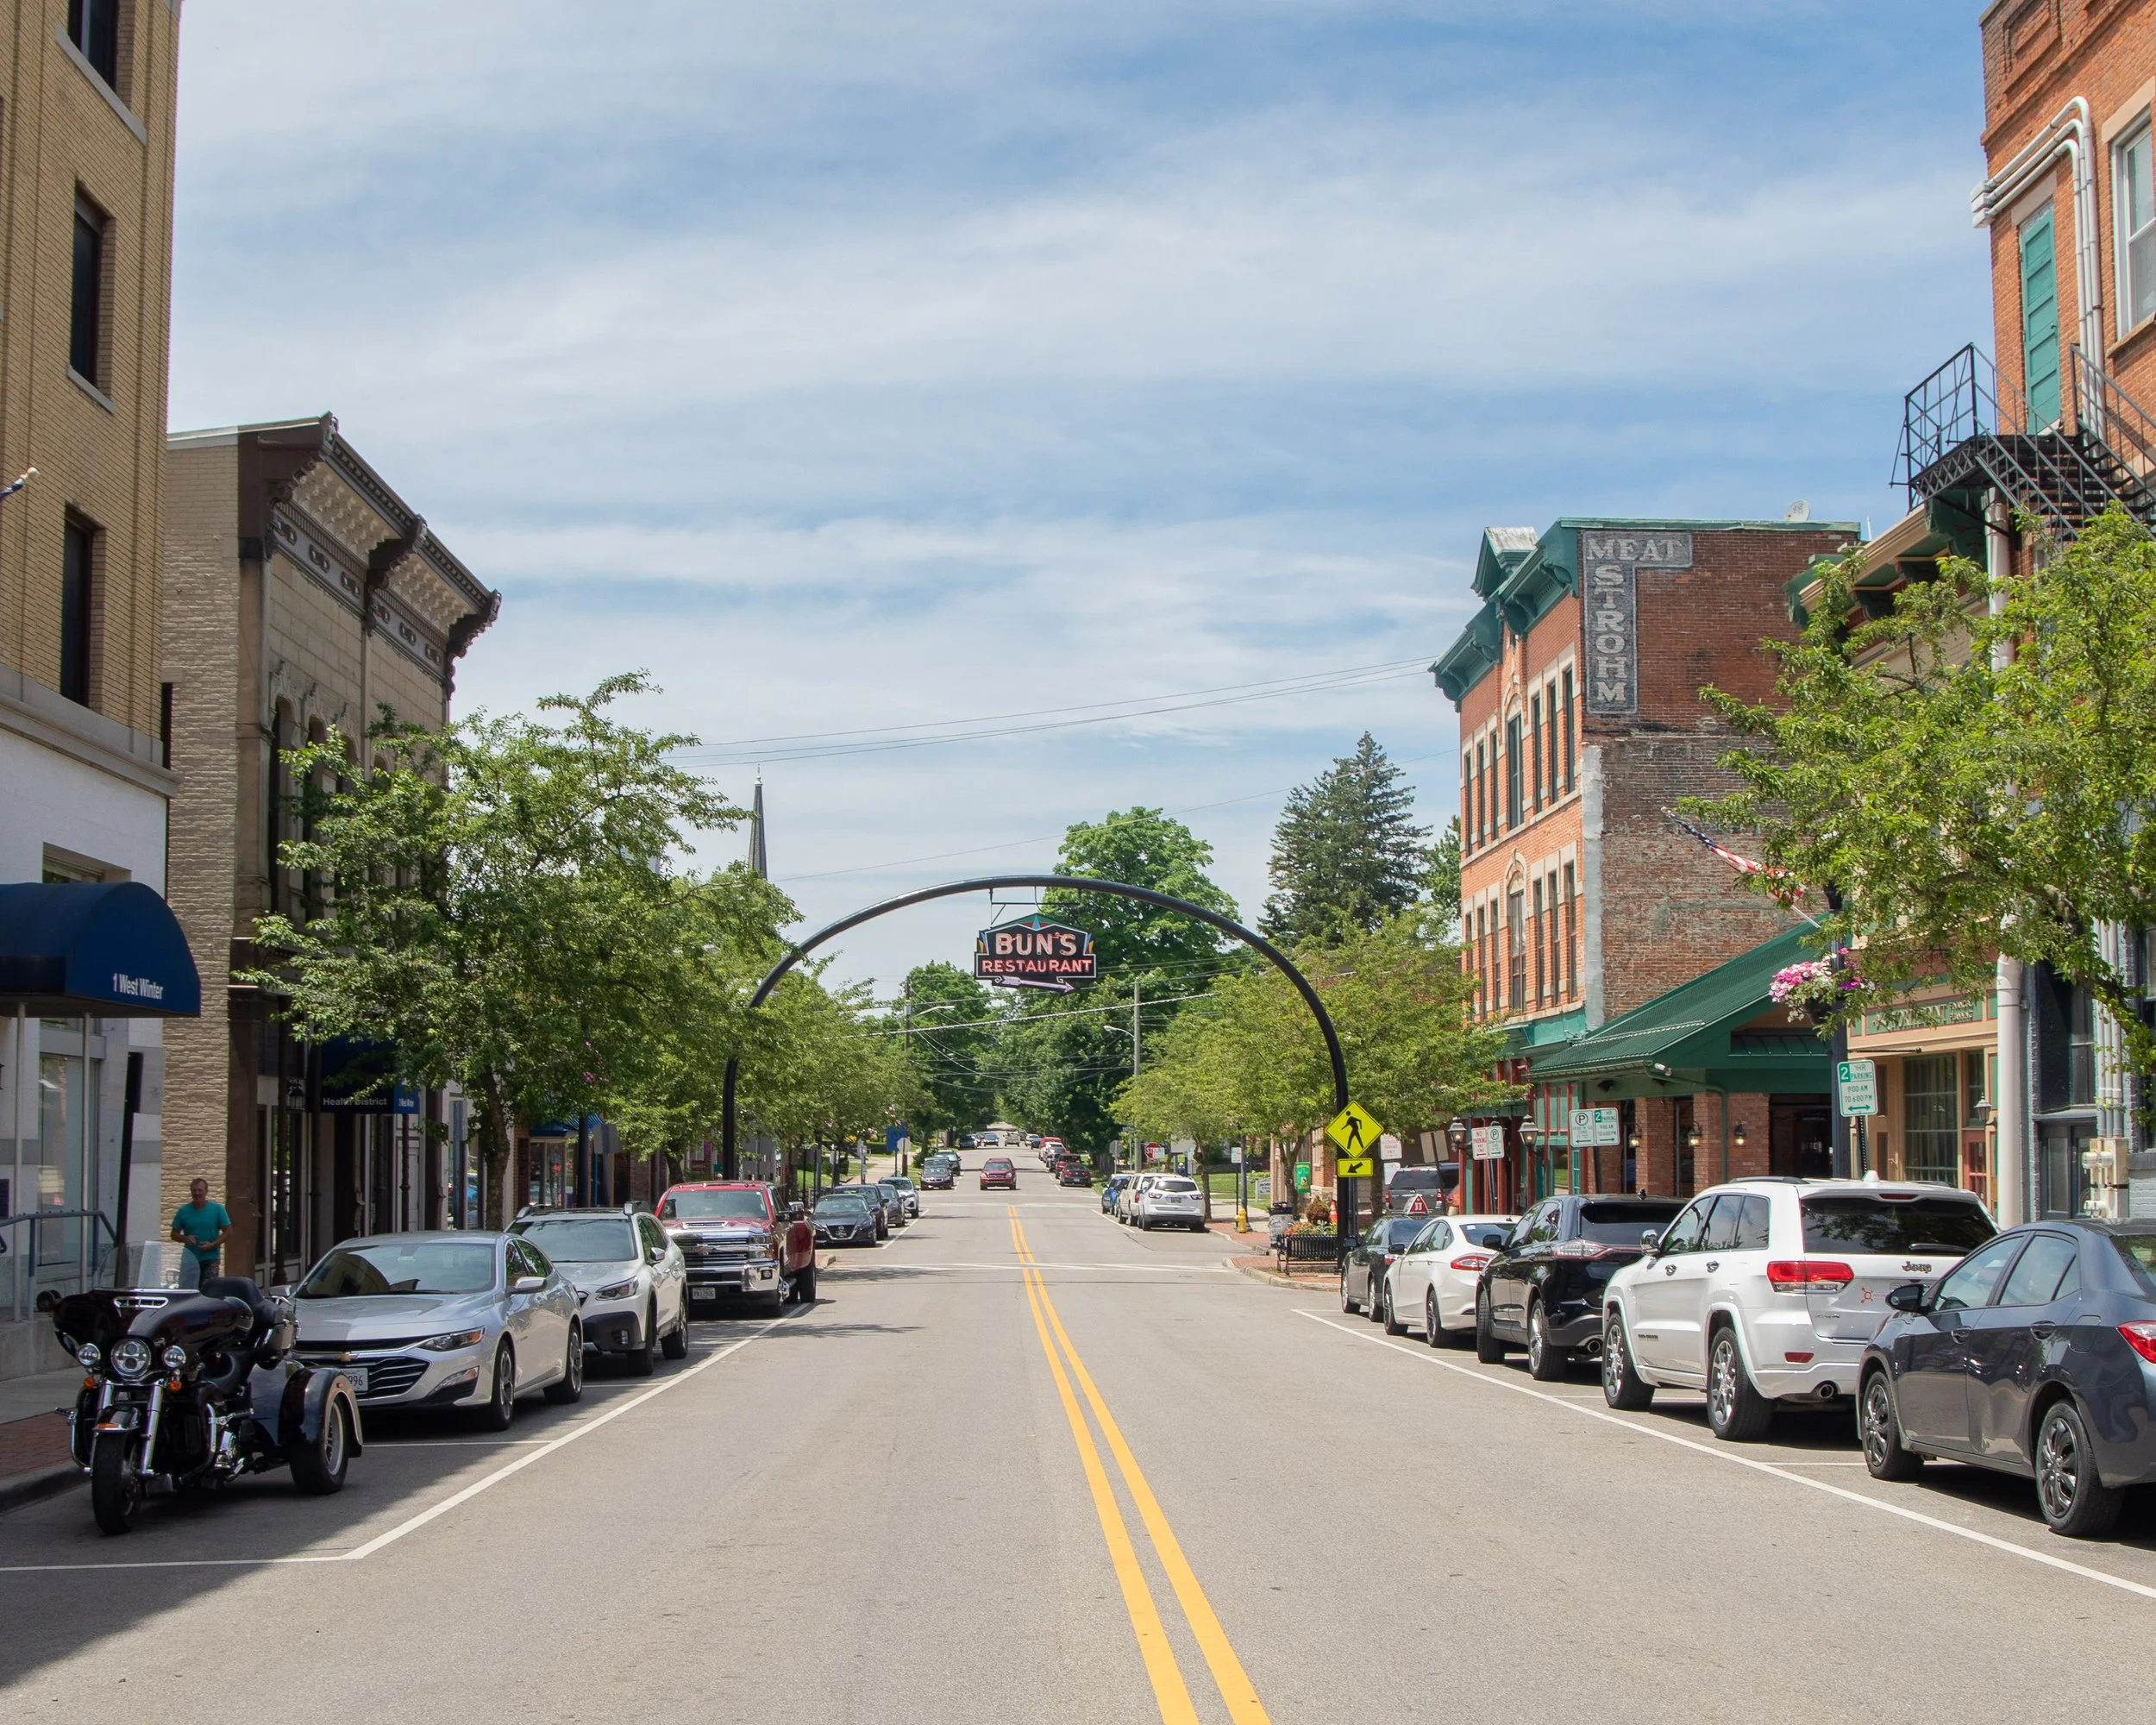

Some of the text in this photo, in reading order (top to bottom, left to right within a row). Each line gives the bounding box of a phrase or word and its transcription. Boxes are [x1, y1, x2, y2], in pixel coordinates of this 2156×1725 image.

[1587, 538, 1683, 561] MEAT
[1593, 564, 1626, 703] STROHM
[995, 932, 1077, 956] BUN'S
[981, 959, 1093, 973] RESTAURANT
[113, 973, 163, 1000] 1 West Winter
[1840, 1066, 1849, 1080] 2
[1595, 1112, 1601, 1121] 2
[1902, 1261, 1932, 1274] Jeep
